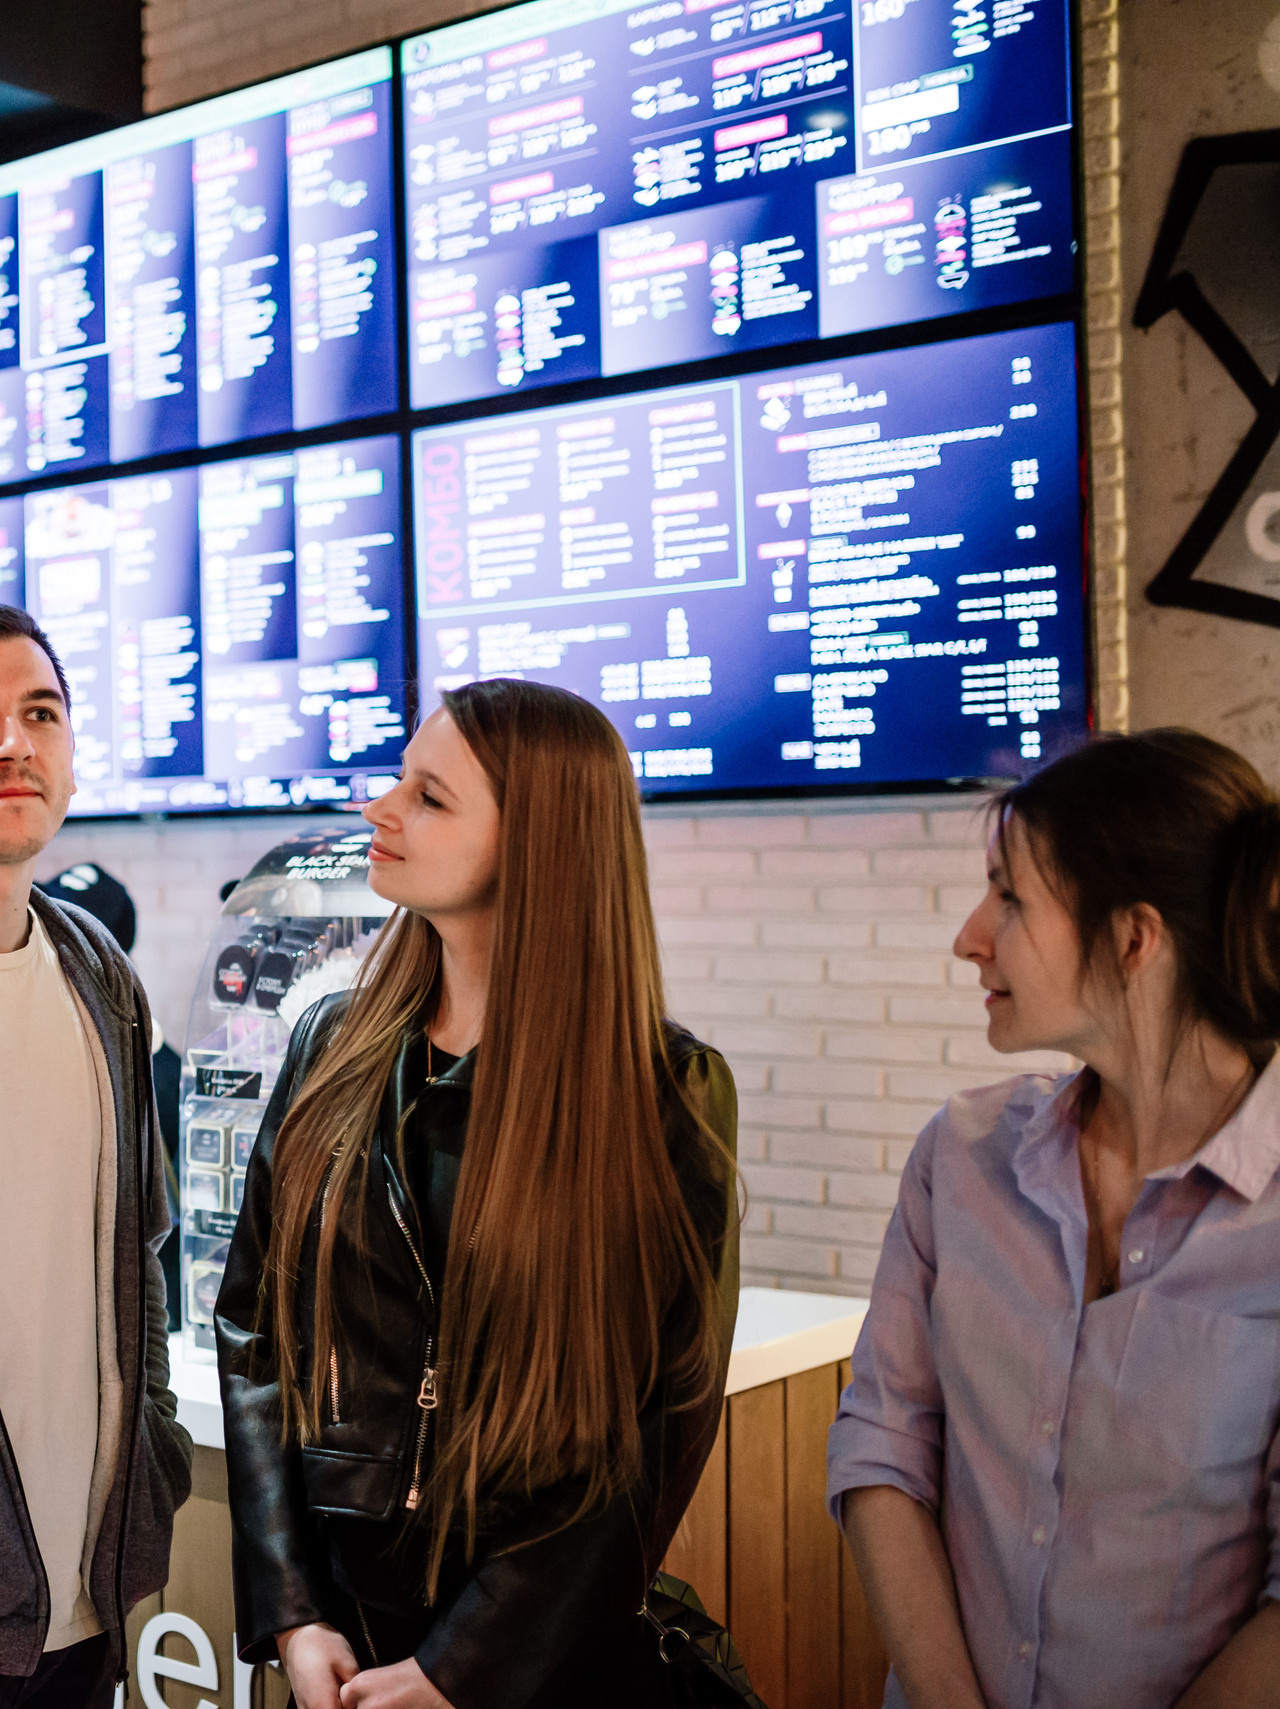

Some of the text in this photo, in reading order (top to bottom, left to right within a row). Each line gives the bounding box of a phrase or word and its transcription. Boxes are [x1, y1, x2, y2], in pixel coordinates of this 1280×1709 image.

[423, 444, 464, 604] КОМБО
[285, 855, 337, 868] BLACK
[286, 867, 351, 879] BURGER
